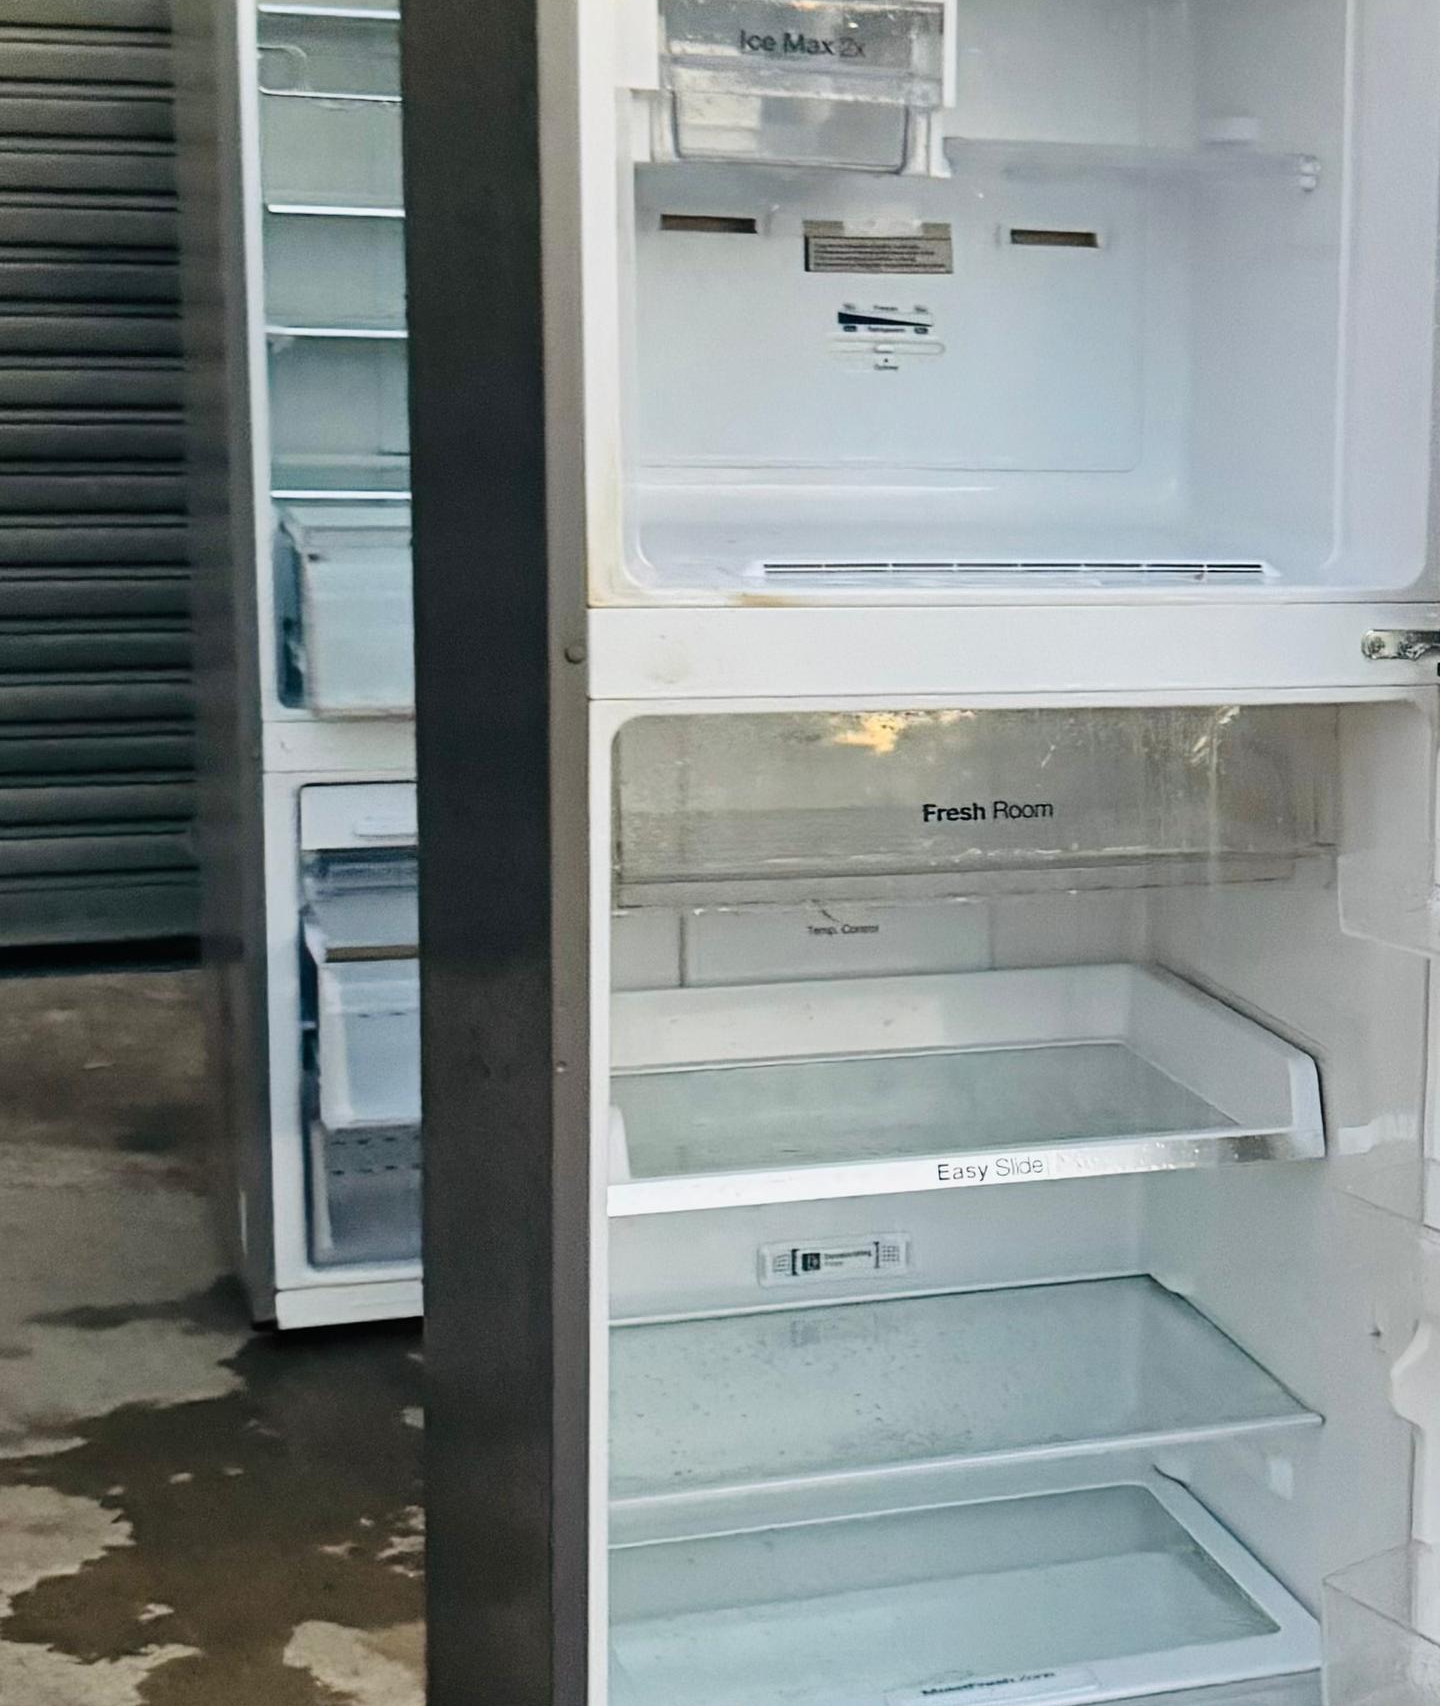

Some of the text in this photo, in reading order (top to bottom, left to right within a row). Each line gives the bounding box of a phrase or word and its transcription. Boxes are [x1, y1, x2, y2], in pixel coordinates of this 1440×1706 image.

[739, 29, 776, 52] Ice
[783, 32, 834, 56] Max
[922, 801, 1053, 822] Fresh Room
[937, 1157, 1043, 1181] Easy Slide
